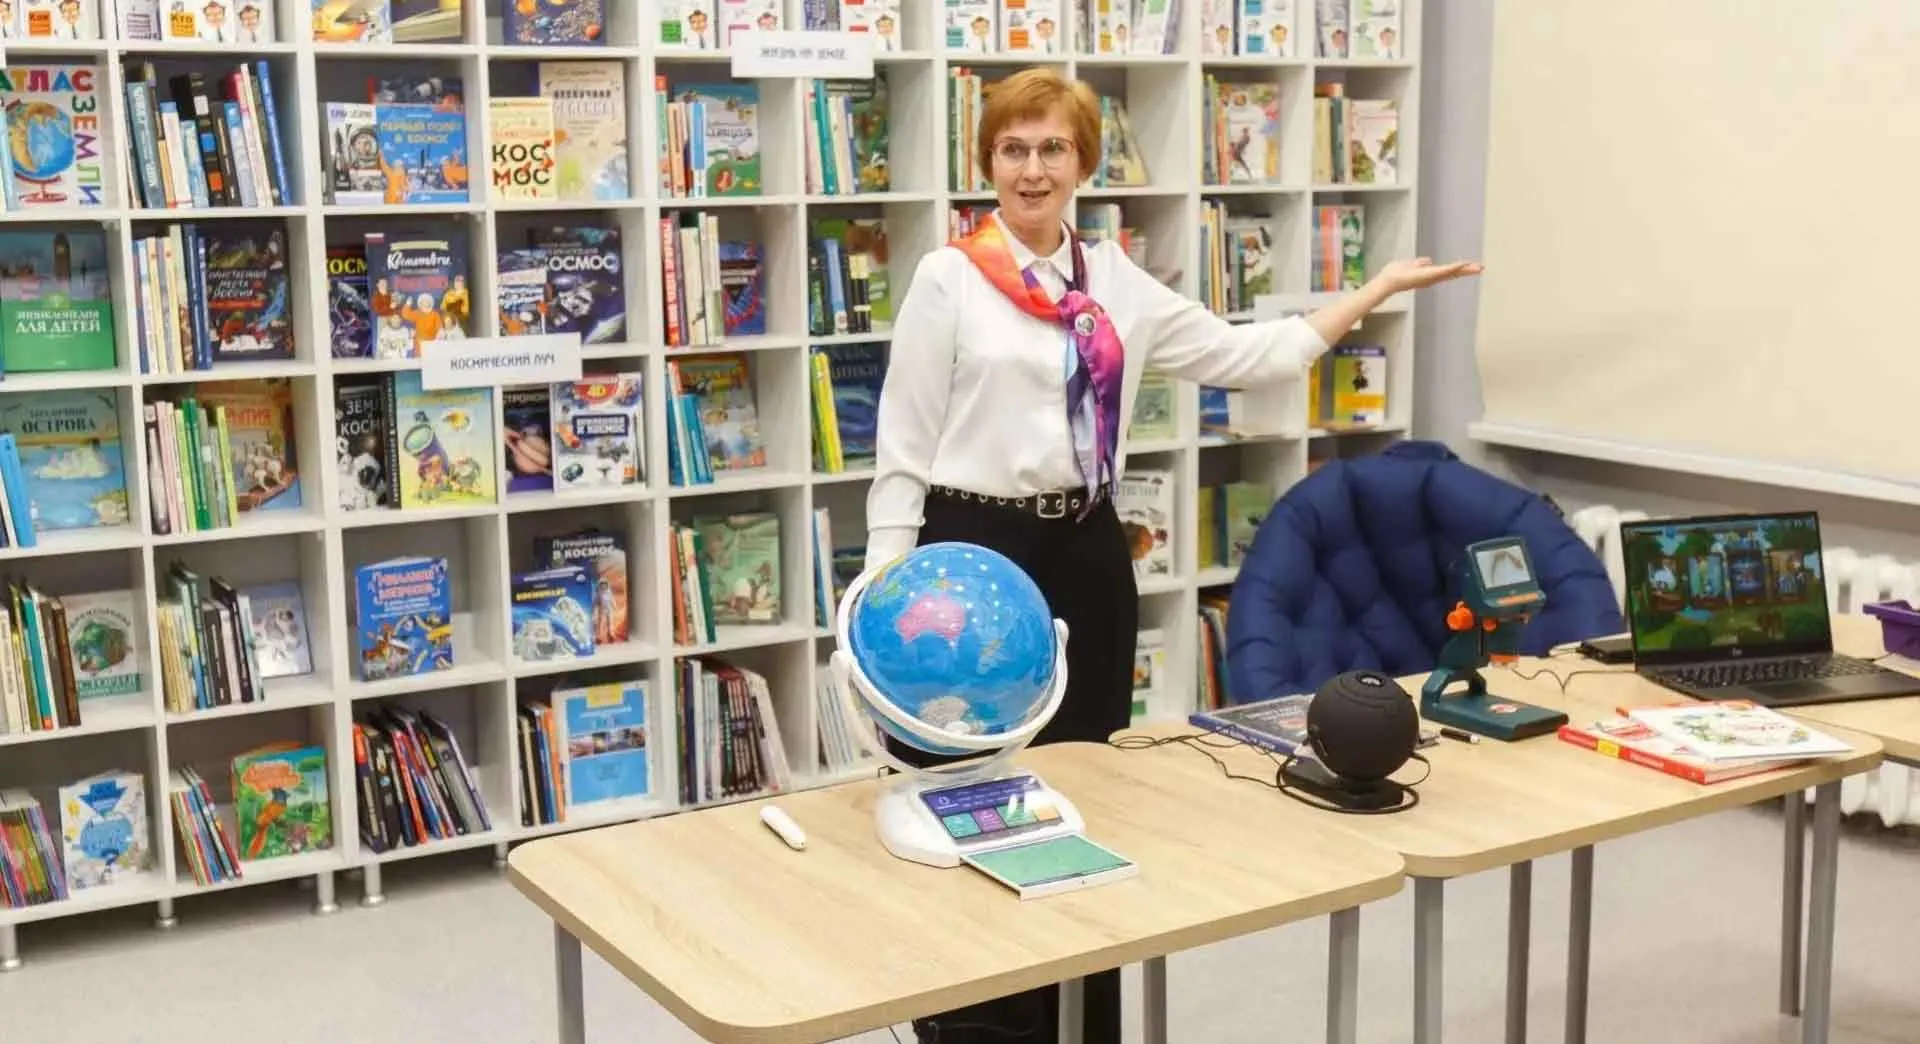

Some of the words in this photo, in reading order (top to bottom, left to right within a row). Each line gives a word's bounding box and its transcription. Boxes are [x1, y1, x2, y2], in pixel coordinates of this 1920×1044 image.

[0, 69, 94, 93] АТЛАС
[71, 96, 102, 205] ЗЕМЛИ
[491, 143, 549, 164] КОС
[492, 166, 550, 186] МОС
[16, 320, 46, 333] ДЛЯ
[51, 319, 101, 333] ДЕТЕЙ
[450, 354, 530, 370] КОСМИЧЕСКИЙ
[533, 351, 556, 366] ЛУЧ
[21, 417, 97, 433] ОСТРОВА
